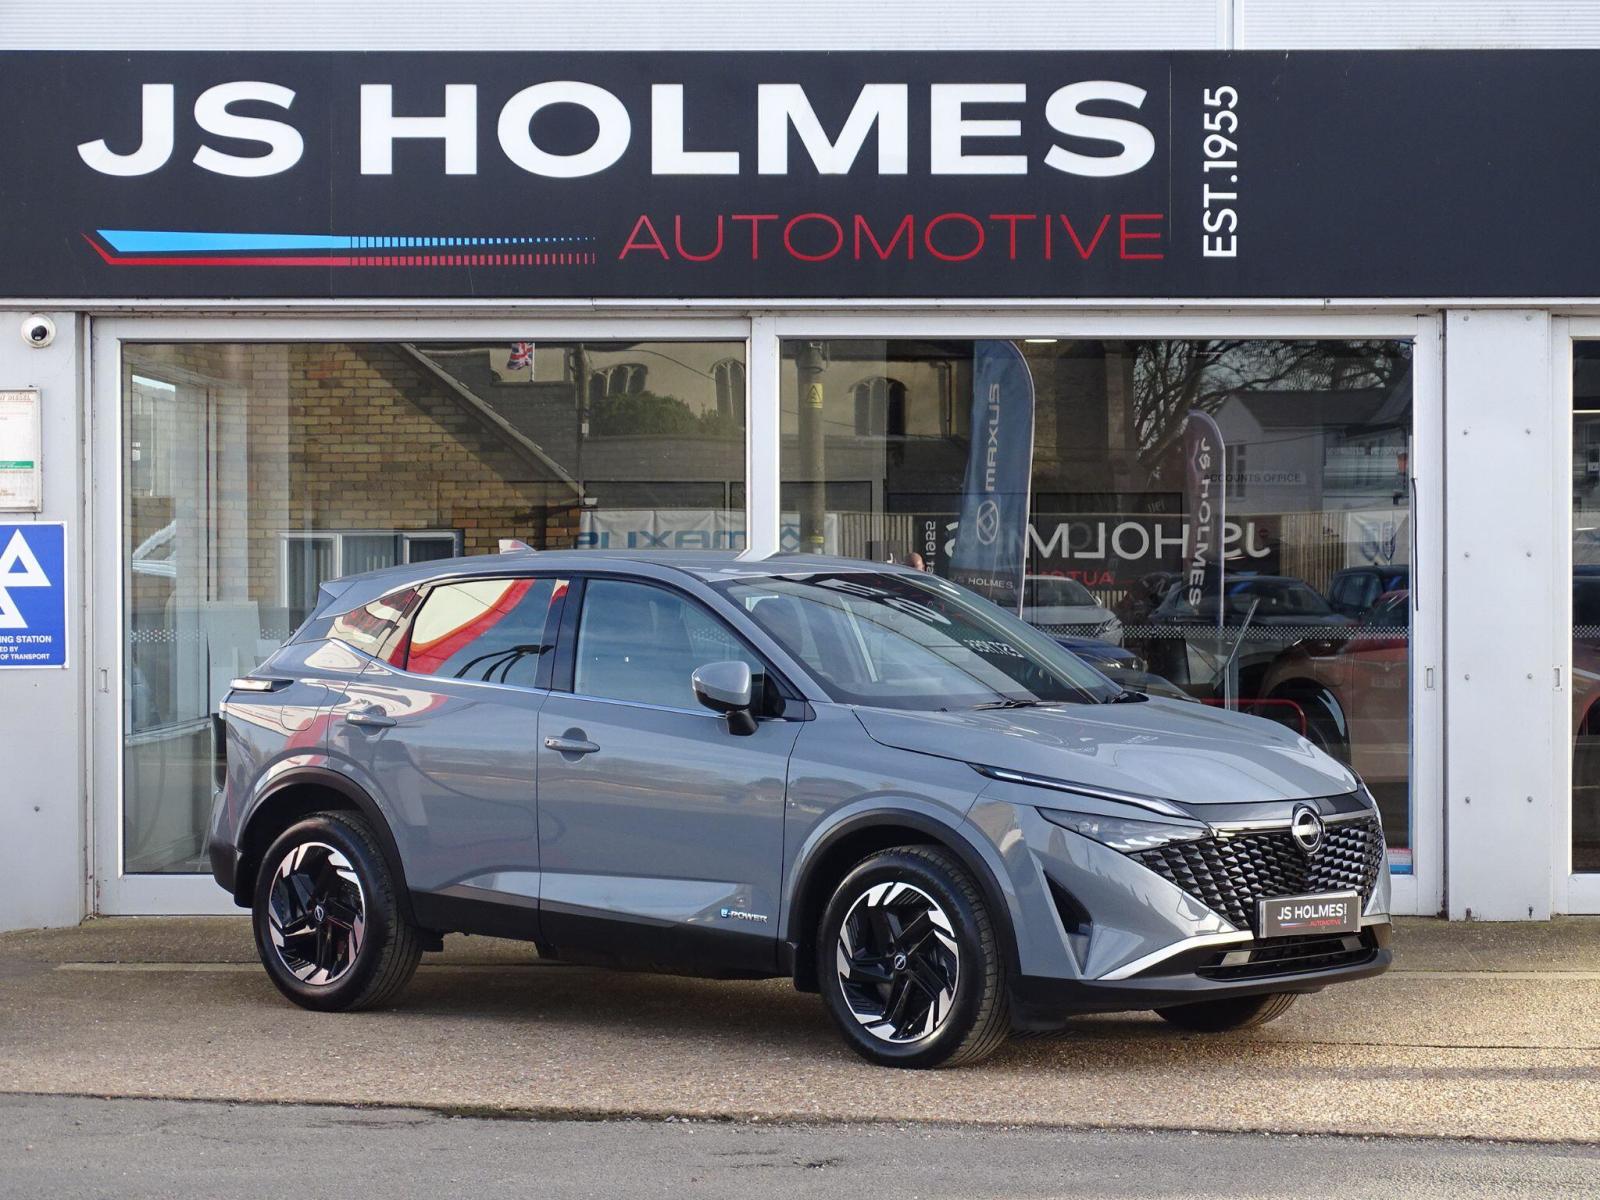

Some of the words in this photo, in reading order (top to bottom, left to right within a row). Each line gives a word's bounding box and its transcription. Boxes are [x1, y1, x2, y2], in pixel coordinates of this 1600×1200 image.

[77, 81, 305, 178] JS
[360, 80, 1156, 178] HOLMES
[1202, 85, 1238, 258] EST.1955
[618, 213, 1164, 261] AUTOMOTIVE
[985, 383, 1000, 492] MAXUS
[1264, 473, 1301, 482] OFFICE
[1188, 478, 1211, 606] HOLMES
[968, 577, 1014, 589] HOLMES
[15, 635, 52, 643] STATION
[1277, 906, 1292, 920] JS
[1294, 903, 1344, 919] HOLMES
